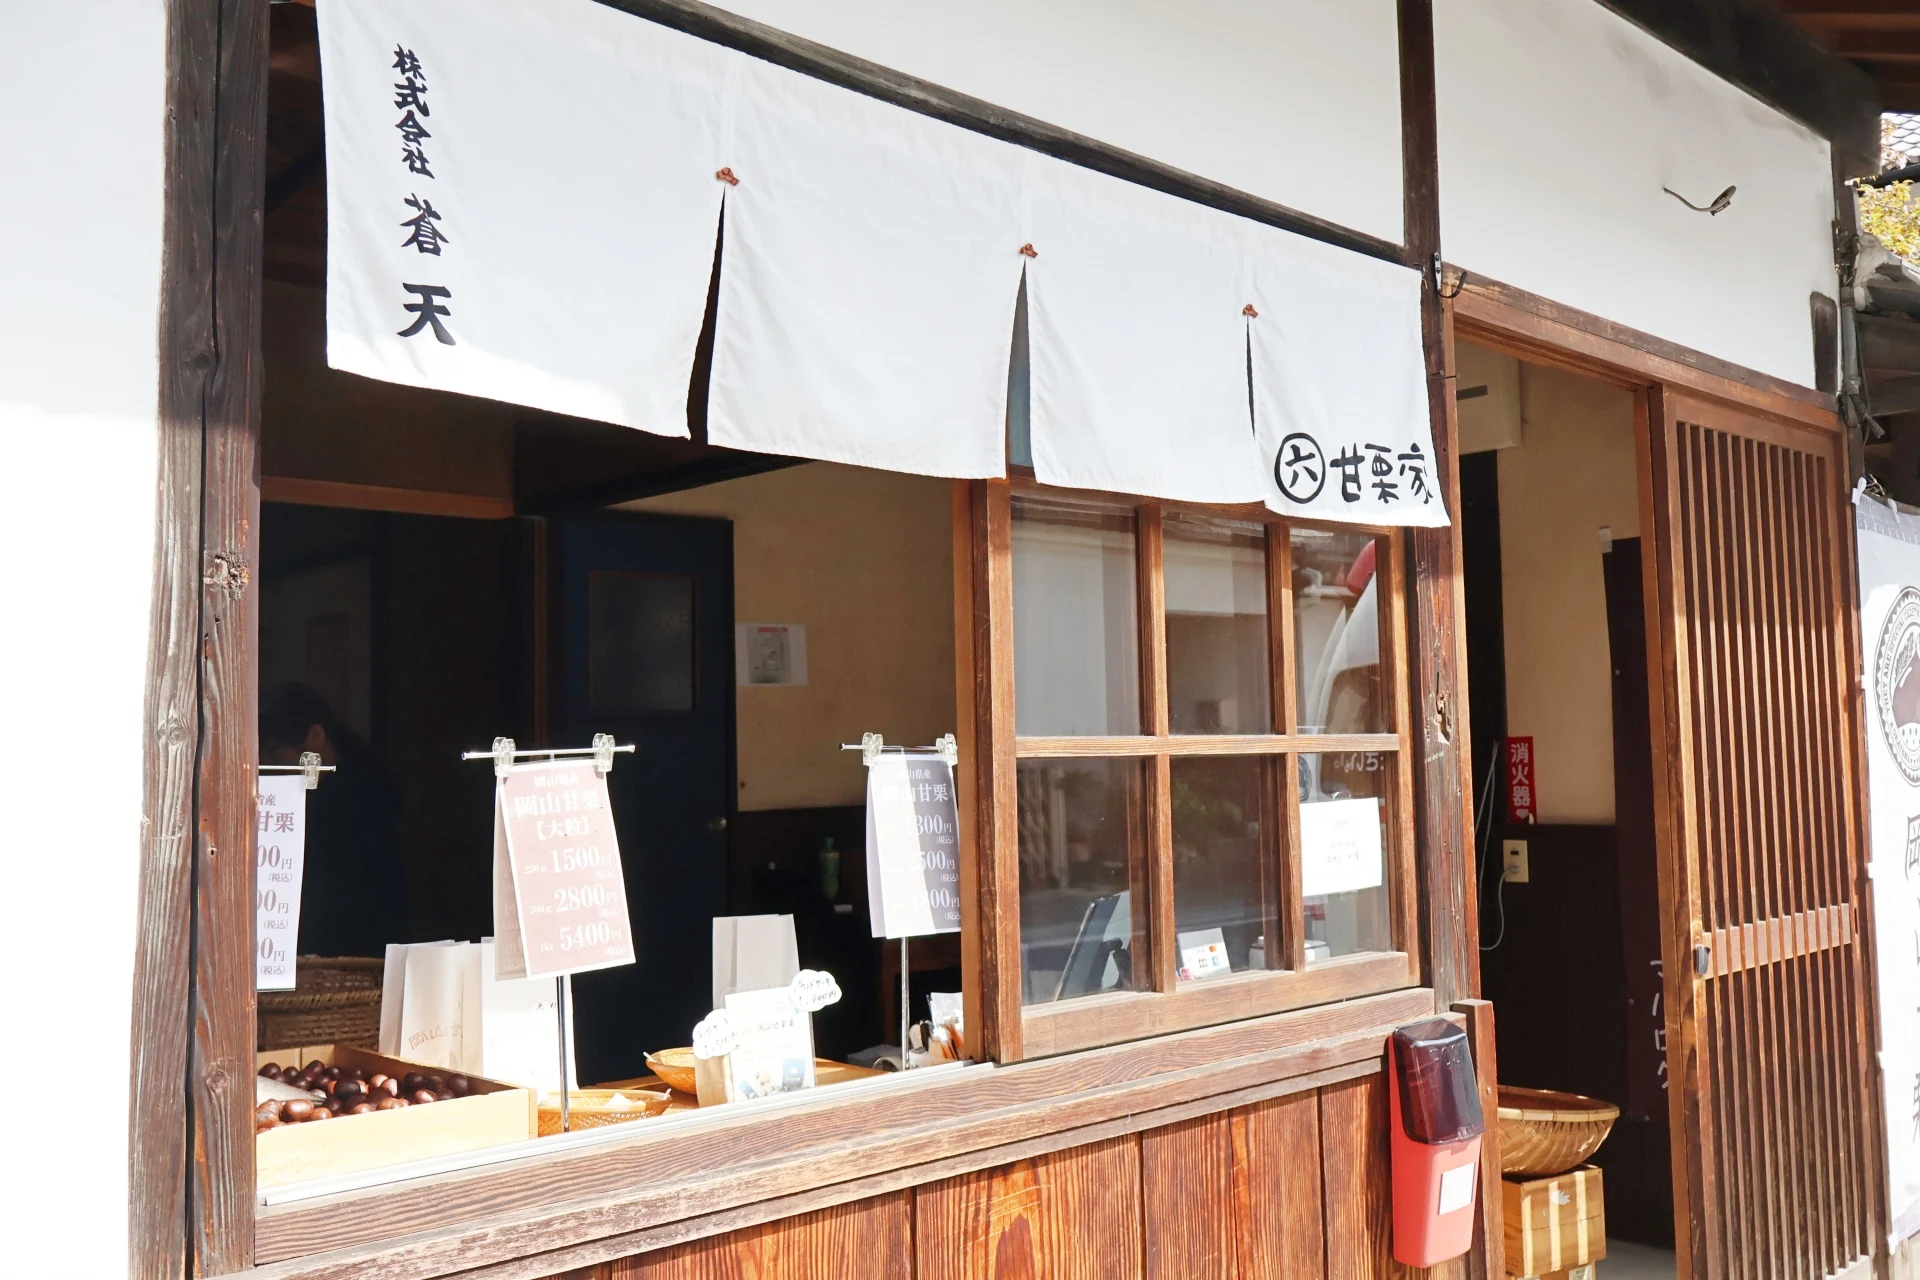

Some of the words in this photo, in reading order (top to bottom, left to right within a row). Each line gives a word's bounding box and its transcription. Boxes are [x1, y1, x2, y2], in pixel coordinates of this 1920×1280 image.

[391, 42, 436, 181] 株式会社
[1329, 442, 1434, 504] 甘栗家
[1510, 742, 1530, 807] 消火器
[514, 787, 601, 819] 岡山甘栗
[550, 844, 612, 874] 1500円
[553, 883, 617, 914] 2800円
[559, 920, 623, 952] 5400円
